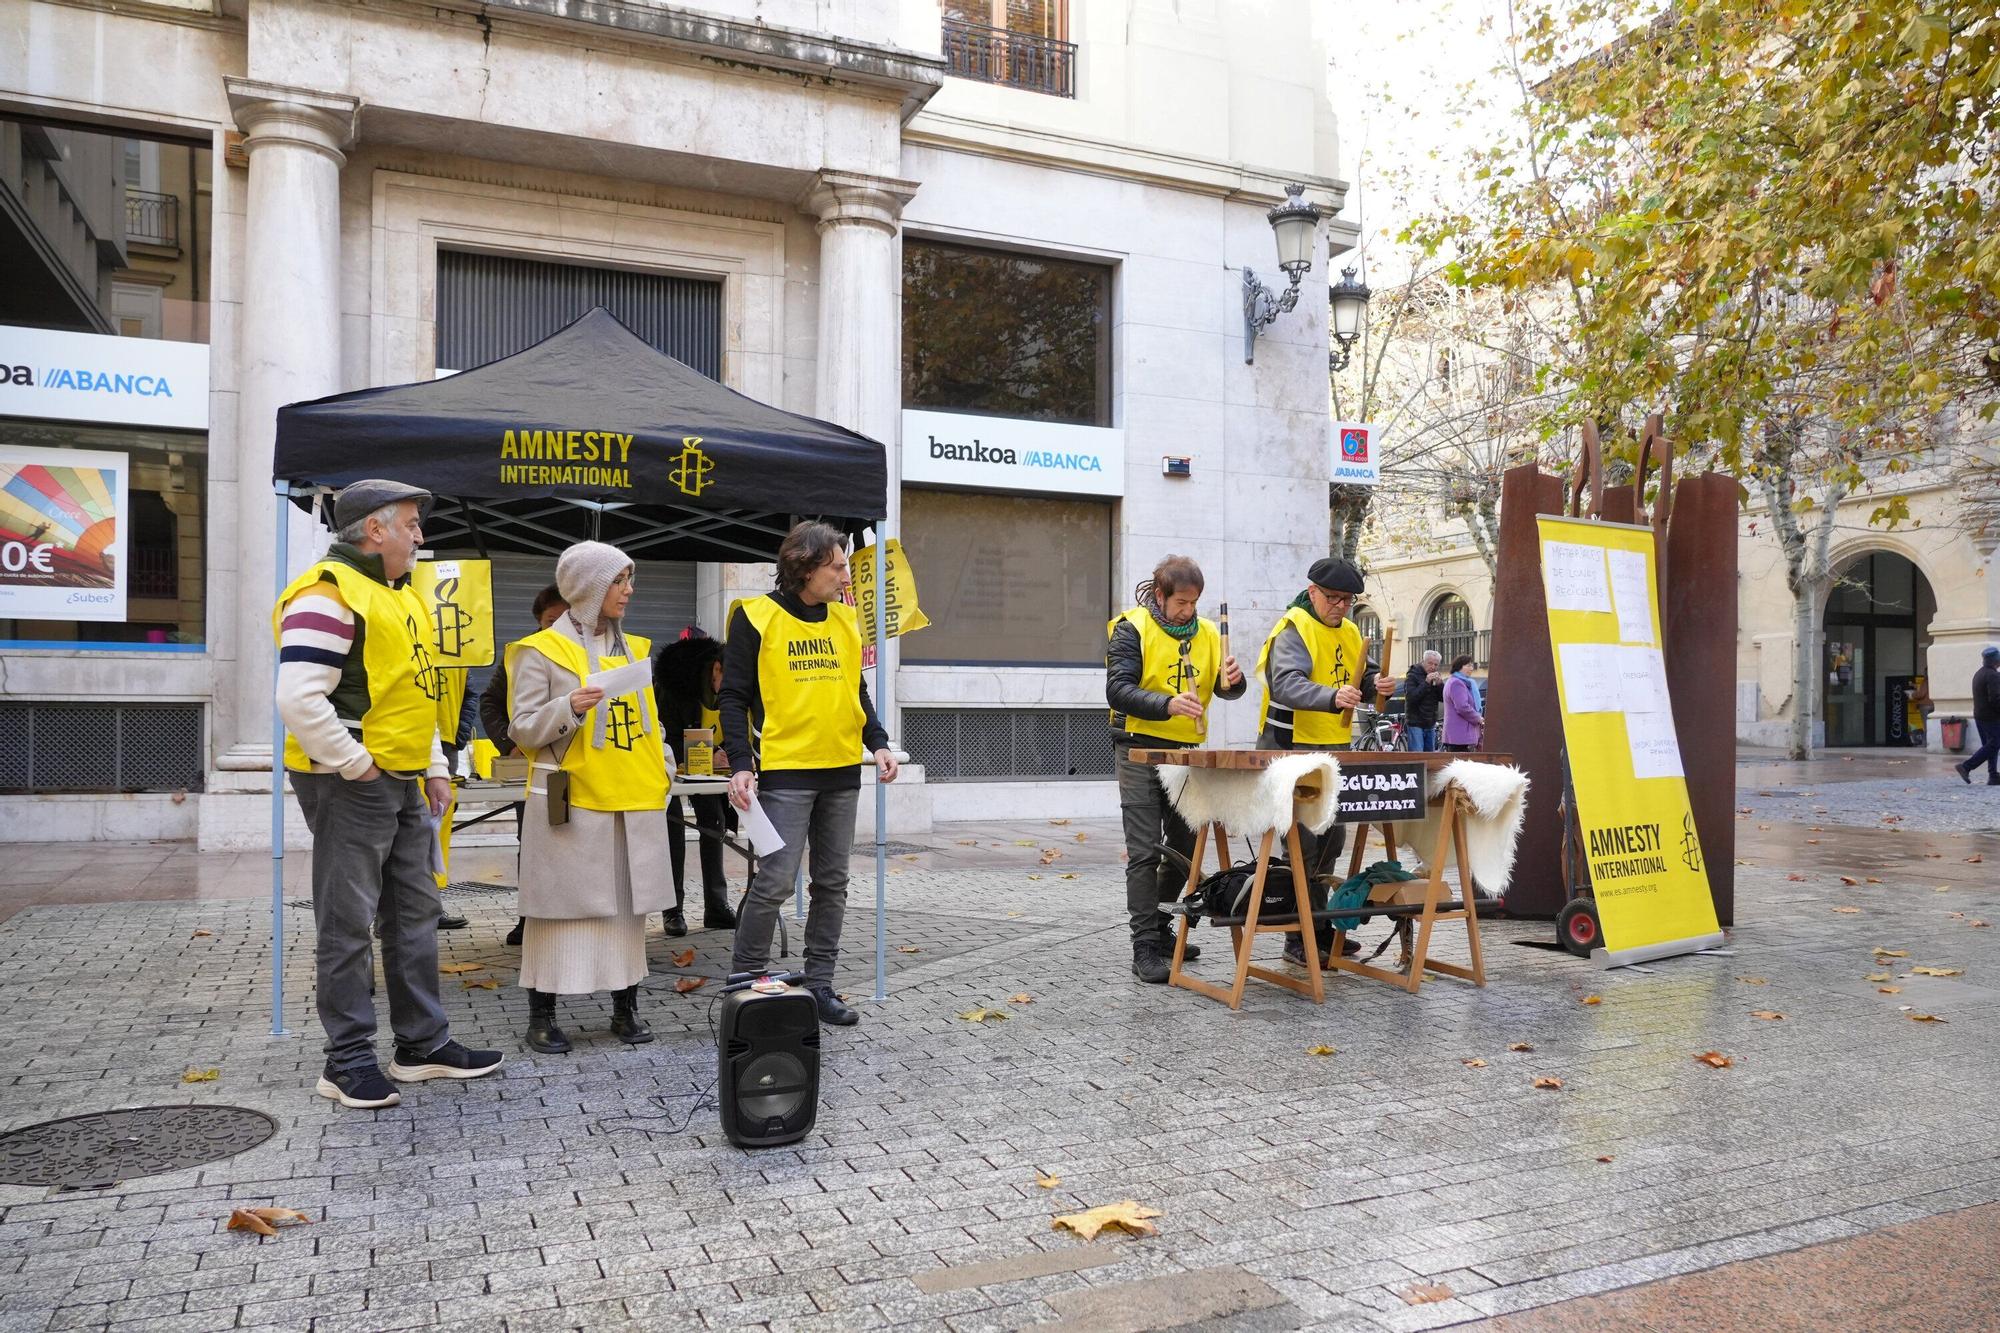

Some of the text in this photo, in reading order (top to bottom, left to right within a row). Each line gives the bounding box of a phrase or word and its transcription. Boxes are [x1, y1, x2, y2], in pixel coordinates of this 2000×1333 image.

[501, 430, 634, 463] AMNESTY
[928, 435, 1017, 465] bankoa
[501, 465, 633, 488] INTERNATIONAL
[1589, 823, 1661, 858] AMNESTY
[1593, 855, 1668, 881] INTERNATIONAL
[1599, 882, 1658, 898] www.es.amnesty.org
